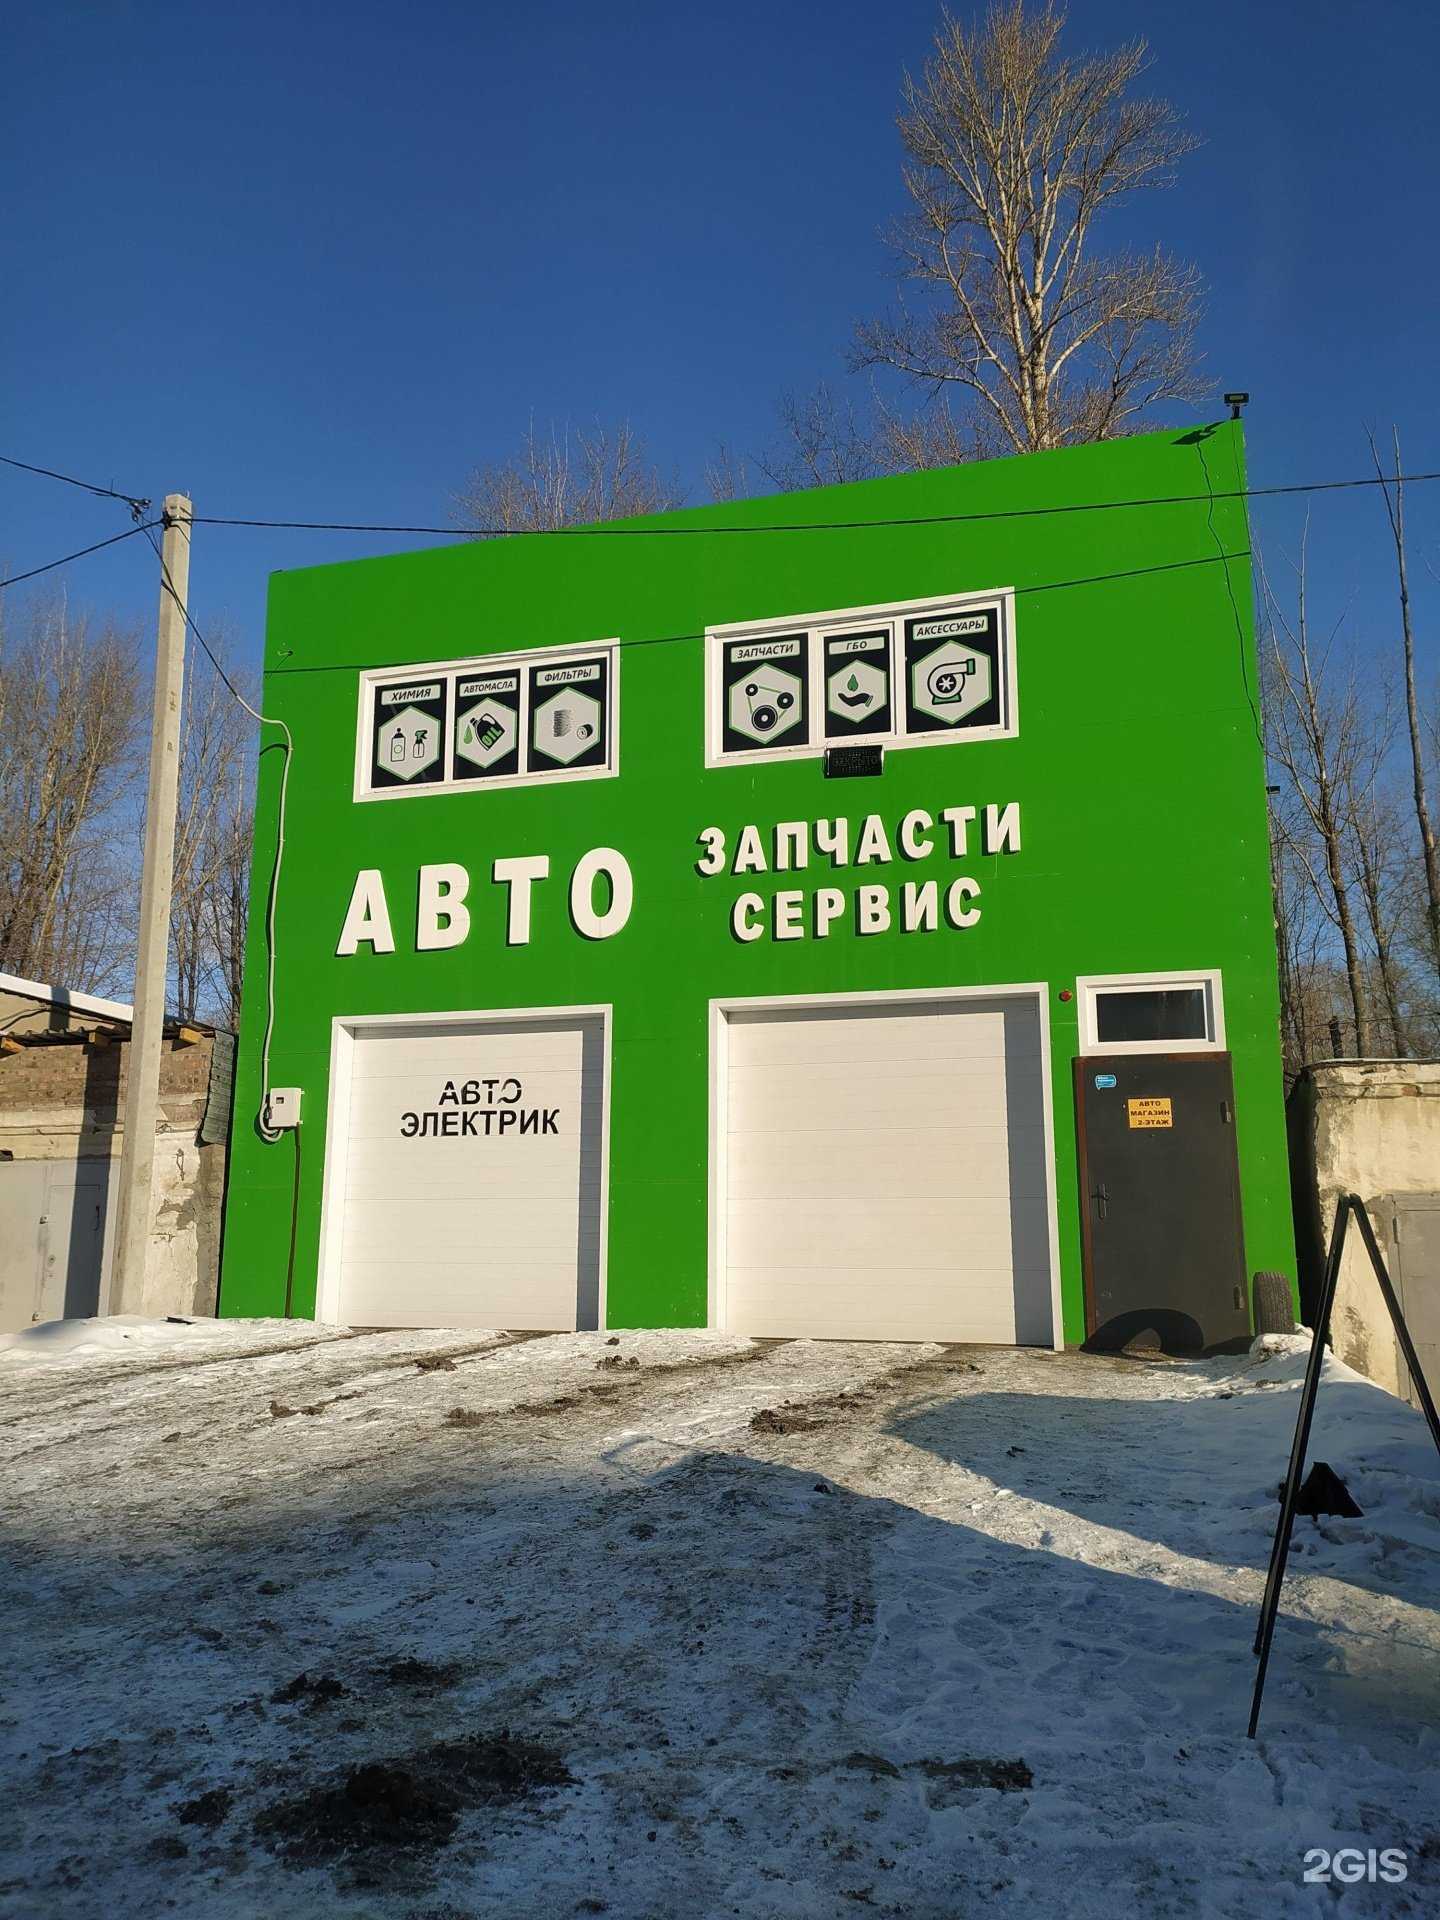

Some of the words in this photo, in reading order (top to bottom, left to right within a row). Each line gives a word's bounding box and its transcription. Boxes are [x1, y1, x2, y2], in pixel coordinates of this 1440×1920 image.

[916, 618, 985, 637] АКСЕССУАРЫ
[736, 643, 794, 660] ЗАПЧАСТИ
[845, 640, 868, 652] ГБО
[544, 668, 592, 682] ФИЛЬТРЫ
[391, 688, 431, 701] ХИМИЯ
[463, 680, 513, 694] АВТОМАСЛА
[481, 726, 502, 746] OIL
[695, 801, 1022, 876] ЗАПЧАСТИ
[335, 846, 634, 957] АВТО
[731, 876, 982, 942] СЕРВИС
[438, 1078, 523, 1106] АВТО
[400, 1108, 560, 1138] ЭЛЕКТРИК
